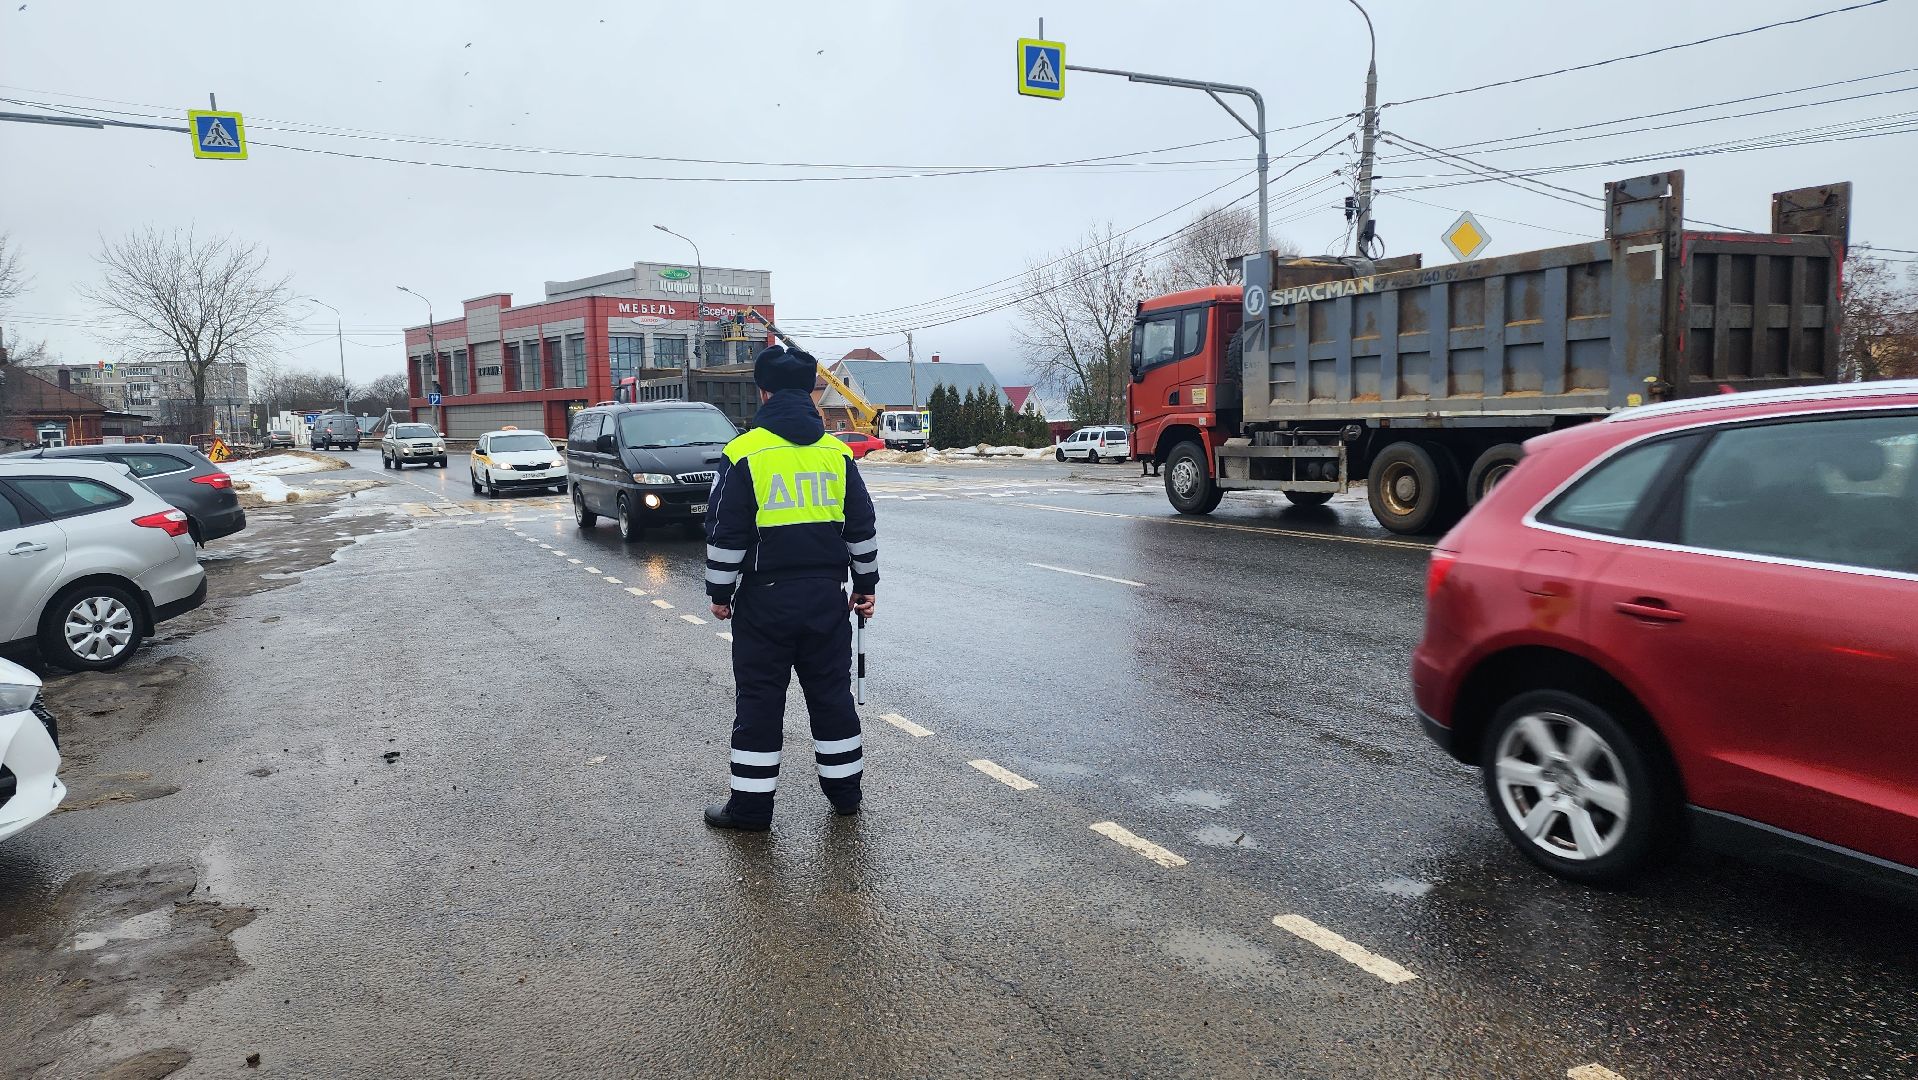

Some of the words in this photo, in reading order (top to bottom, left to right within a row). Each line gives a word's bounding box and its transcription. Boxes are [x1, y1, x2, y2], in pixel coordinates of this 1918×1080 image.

[659, 279, 712, 294] Цифровая
[716, 282, 755, 296] Техника
[1270, 276, 1375, 307] SHACMAN
[618, 303, 676, 315] МЕБЕЛЬ
[764, 472, 838, 510] ДПС
